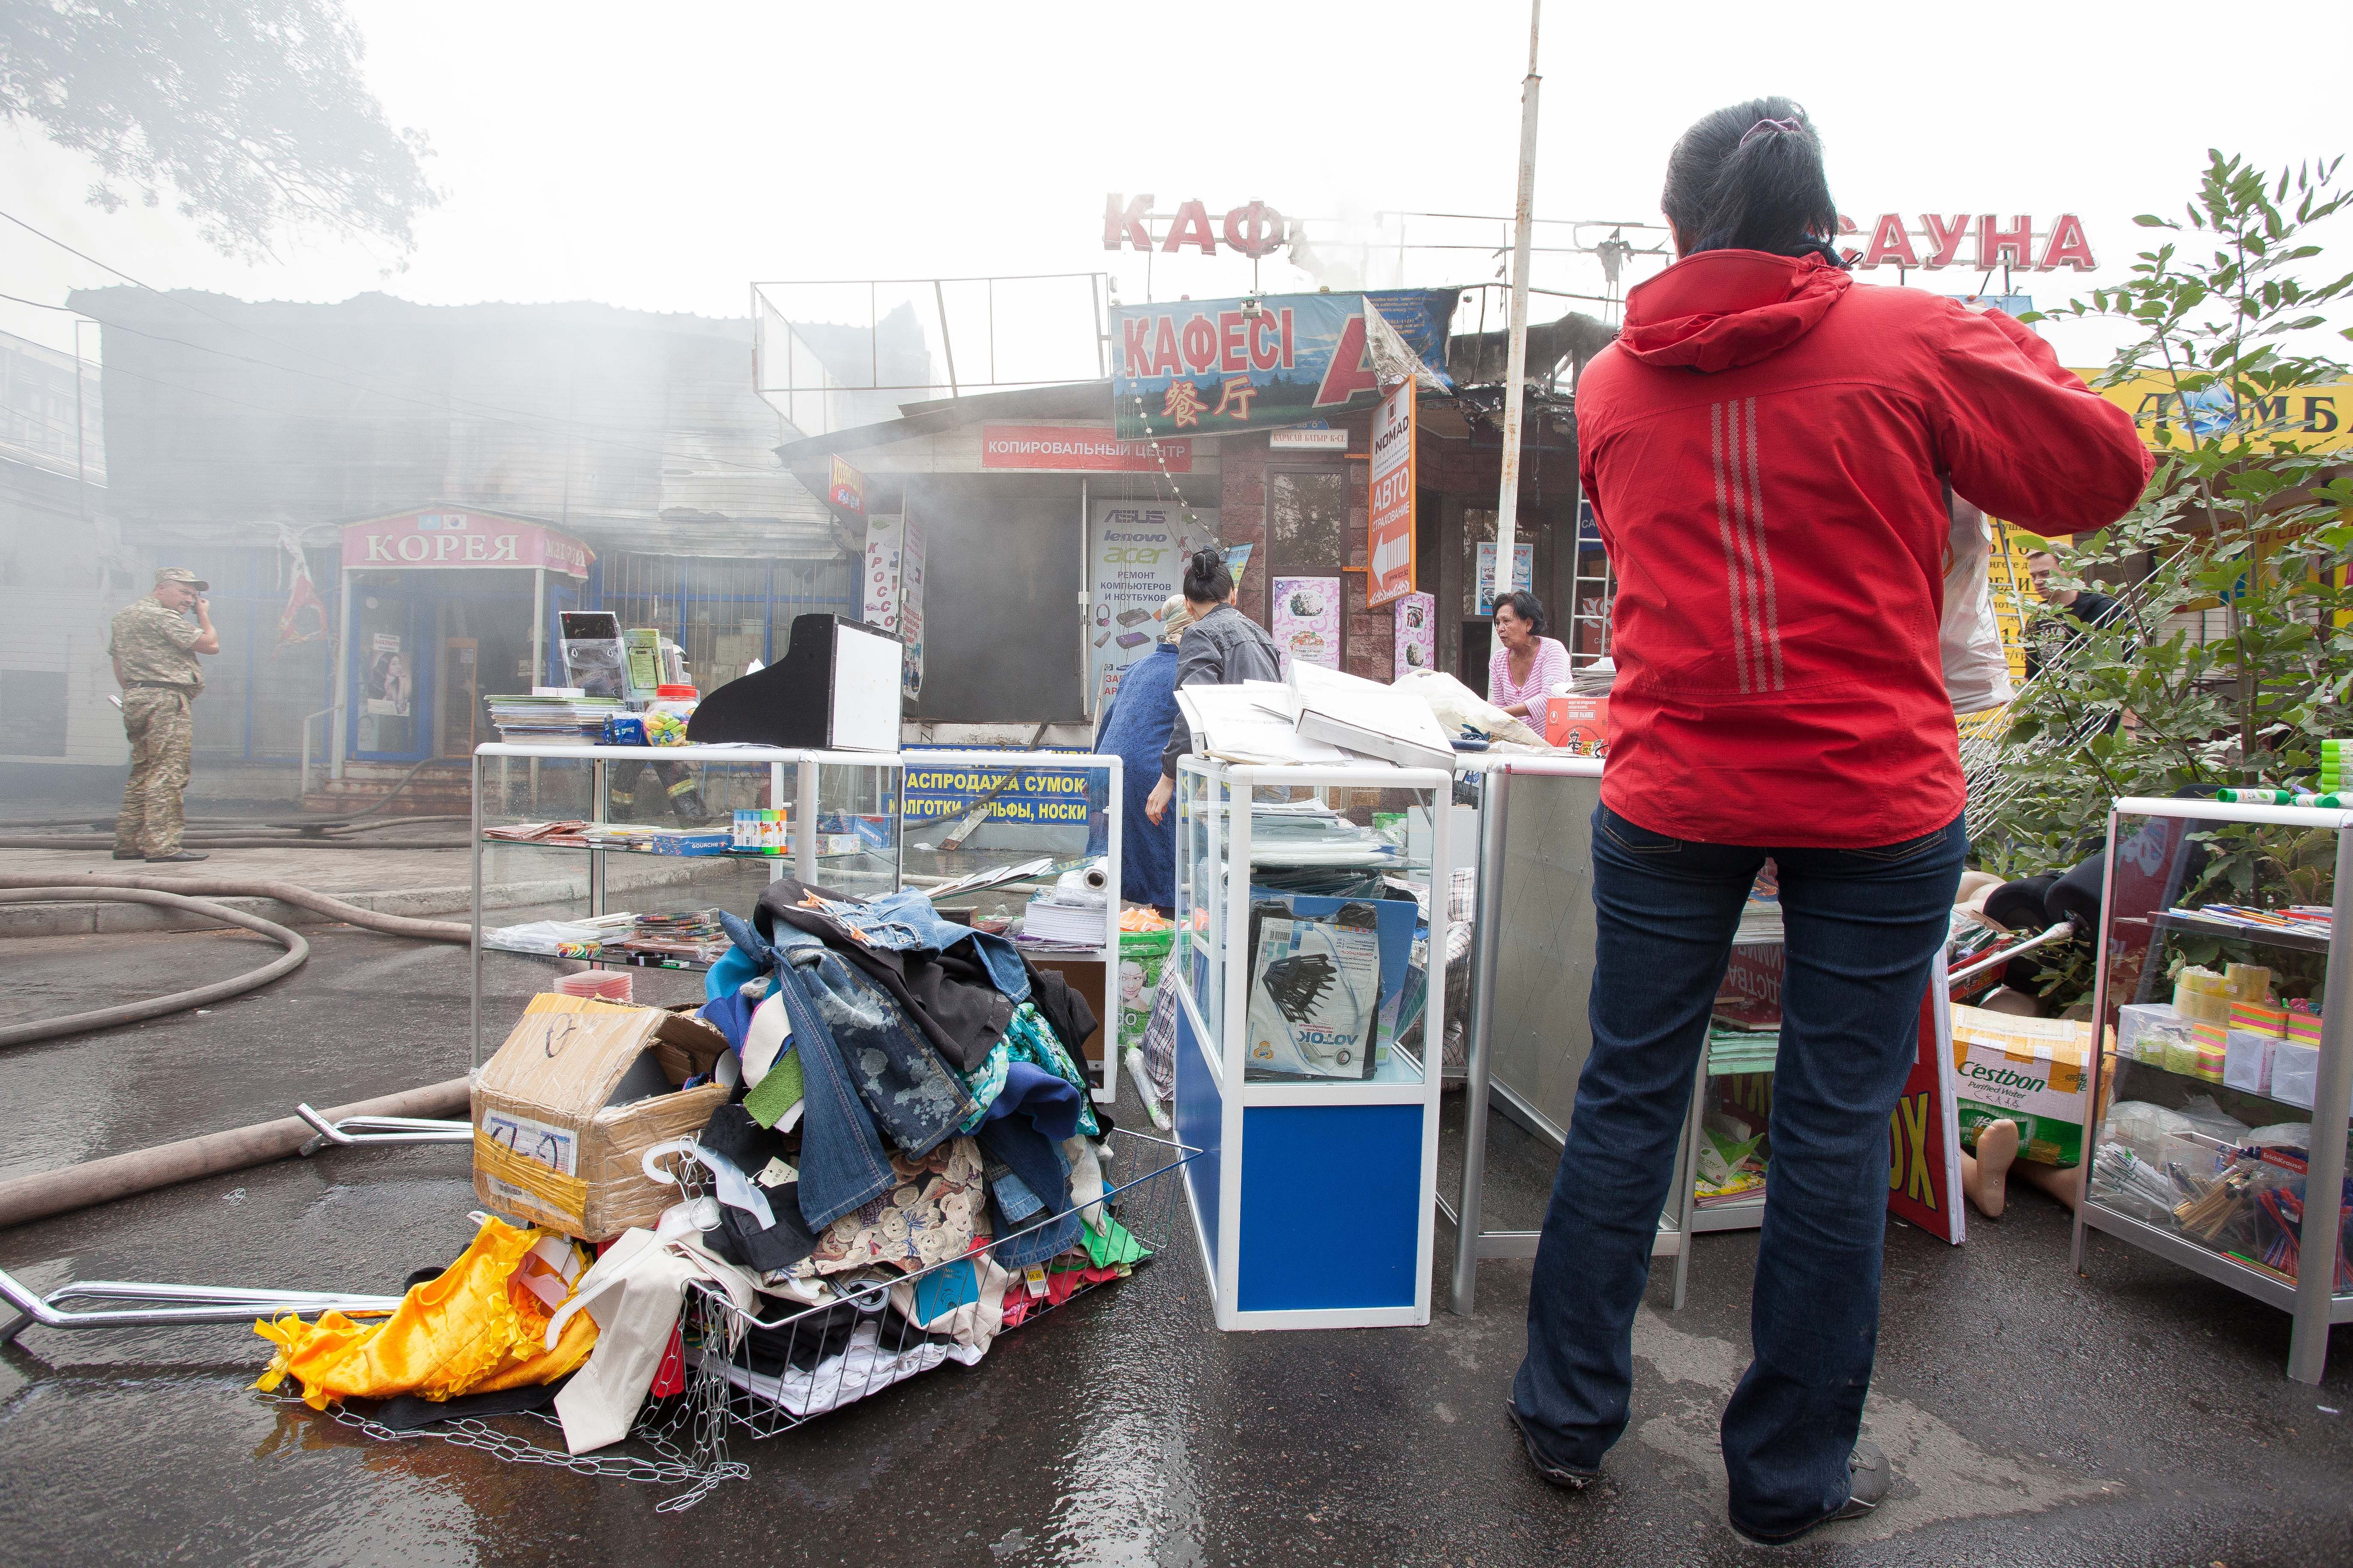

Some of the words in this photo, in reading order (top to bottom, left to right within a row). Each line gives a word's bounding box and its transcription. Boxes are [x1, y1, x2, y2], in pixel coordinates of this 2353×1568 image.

[1161, 376, 1257, 428] 餐厅
[1273, 432, 1302, 442] КАРАСАЙ
[1375, 415, 1409, 455] NOMAD
[988, 440, 1130, 456] КОПИРОВАЛЬНЫЙ
[1135, 445, 1186, 459] ЦЕНТР
[1373, 466, 1409, 515] АВТО
[1104, 509, 1166, 524] ASUS
[1372, 501, 1410, 533] СТРАХОВАНИЕ
[1104, 530, 1167, 542] lenovo
[365, 534, 520, 562] КОРЕЯ
[1103, 547, 1169, 564] acer
[1118, 571, 1155, 579] РЕМОНТ
[1100, 582, 1172, 590] КОМПЬЮТЕРОВ
[1114, 593, 1166, 602] НОУТБУКОВ
[1025, 776, 1085, 793] СУМОК
[970, 802, 1034, 821] ЛЬФЫ,
[1039, 804, 1087, 820] НОСКИ
[1727, 964, 1780, 1005] ДСТВА
[1297, 1030, 1359, 1046] ЛОТОК
[1340, 1053, 1346, 1062] 7
[1967, 1081, 2000, 1094] Purified
[2001, 1088, 2026, 1099] Water
[2262, 1153, 2302, 1170] ErichKrause
